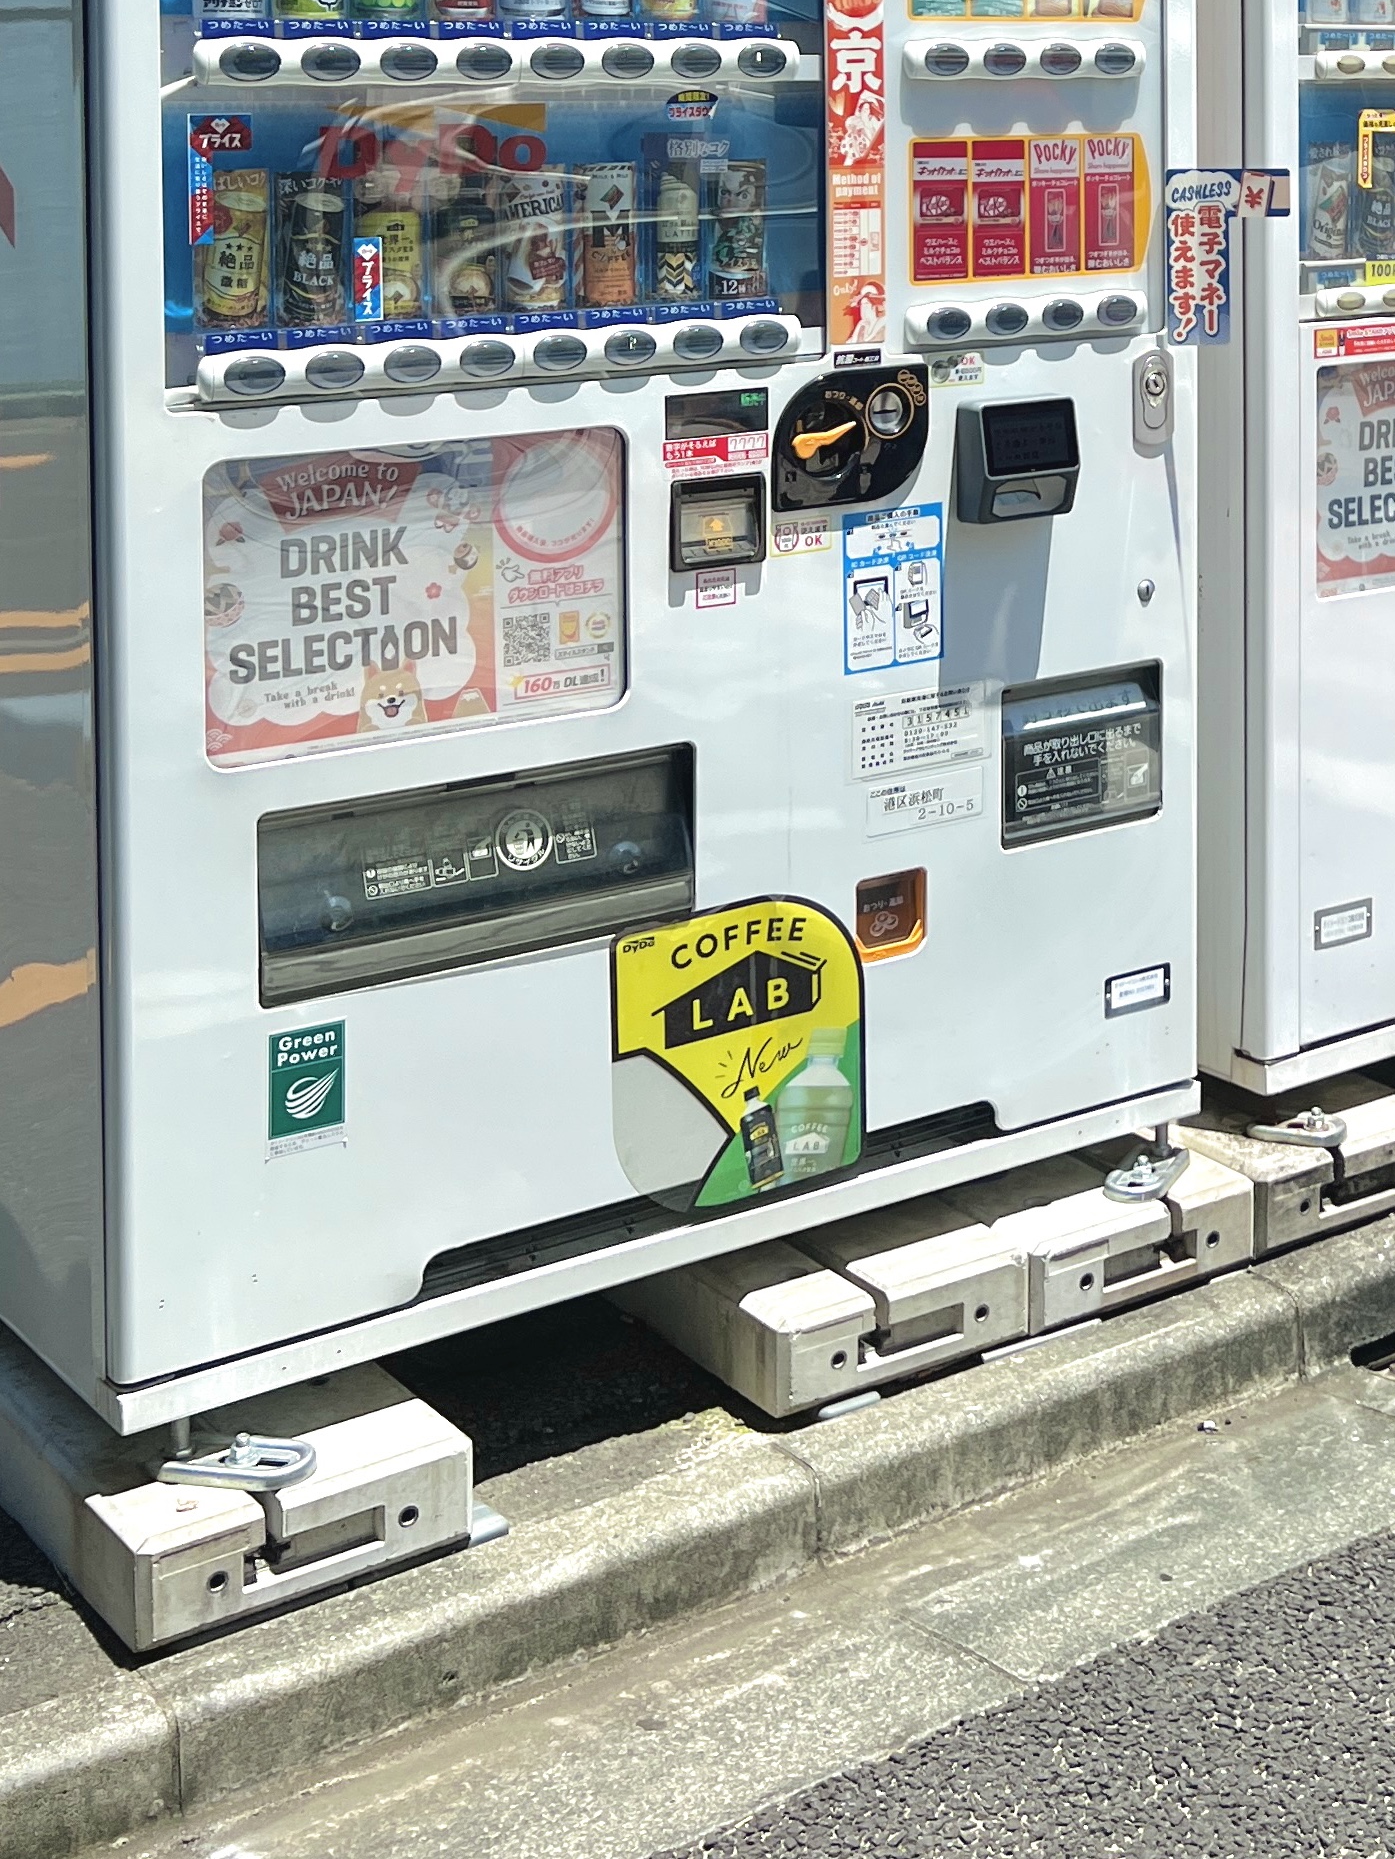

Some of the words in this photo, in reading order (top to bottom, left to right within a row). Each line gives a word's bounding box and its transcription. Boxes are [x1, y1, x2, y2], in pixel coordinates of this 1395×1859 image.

[829, 31, 882, 94] 京
[199, 133, 242, 149] プライス
[667, 139, 730, 158] 格別なコク
[318, 123, 547, 193] DyDo
[832, 172, 870, 185] Method
[871, 172, 882, 184] of
[835, 184, 878, 198] payment
[1171, 180, 1232, 203] CASHLESS
[218, 251, 255, 271] 絶品
[298, 252, 334, 270] 絶品
[1198, 204, 1223, 332] 電子マネー
[293, 271, 334, 287] BLACK
[1171, 212, 1196, 338] 使えます!
[361, 261, 375, 316] プライス
[664, 438, 717, 450] 数字がそろえば
[665, 450, 694, 460] もう1本
[276, 461, 370, 491] Welcome
[377, 461, 398, 481] to
[286, 481, 397, 520] JAPAN!
[804, 534, 823, 547] OK
[280, 526, 409, 579] DRINK
[527, 564, 584, 586] 無料アプリ
[291, 575, 397, 627] BEST
[508, 578, 605, 605] ダウンロードはコチラ
[264, 691, 290, 703] Take
[306, 681, 338, 694] break
[283, 696, 306, 709] with
[324, 687, 356, 702] drink!
[1023, 722, 1142, 756] 商品が取り出し口に出るまで
[884, 787, 945, 812] 港区浜松町
[917, 798, 974, 821] 2-10-5
[622, 938, 655, 954] DyDo
[671, 917, 807, 969] COFFEE
[692, 977, 790, 1031] LAB
[278, 1030, 336, 1052] Green
[277, 1044, 338, 1067] Power
[721, 1036, 803, 1099] New
[790, 1122, 829, 1133] COFFEE
[793, 1140, 820, 1152] LAB
